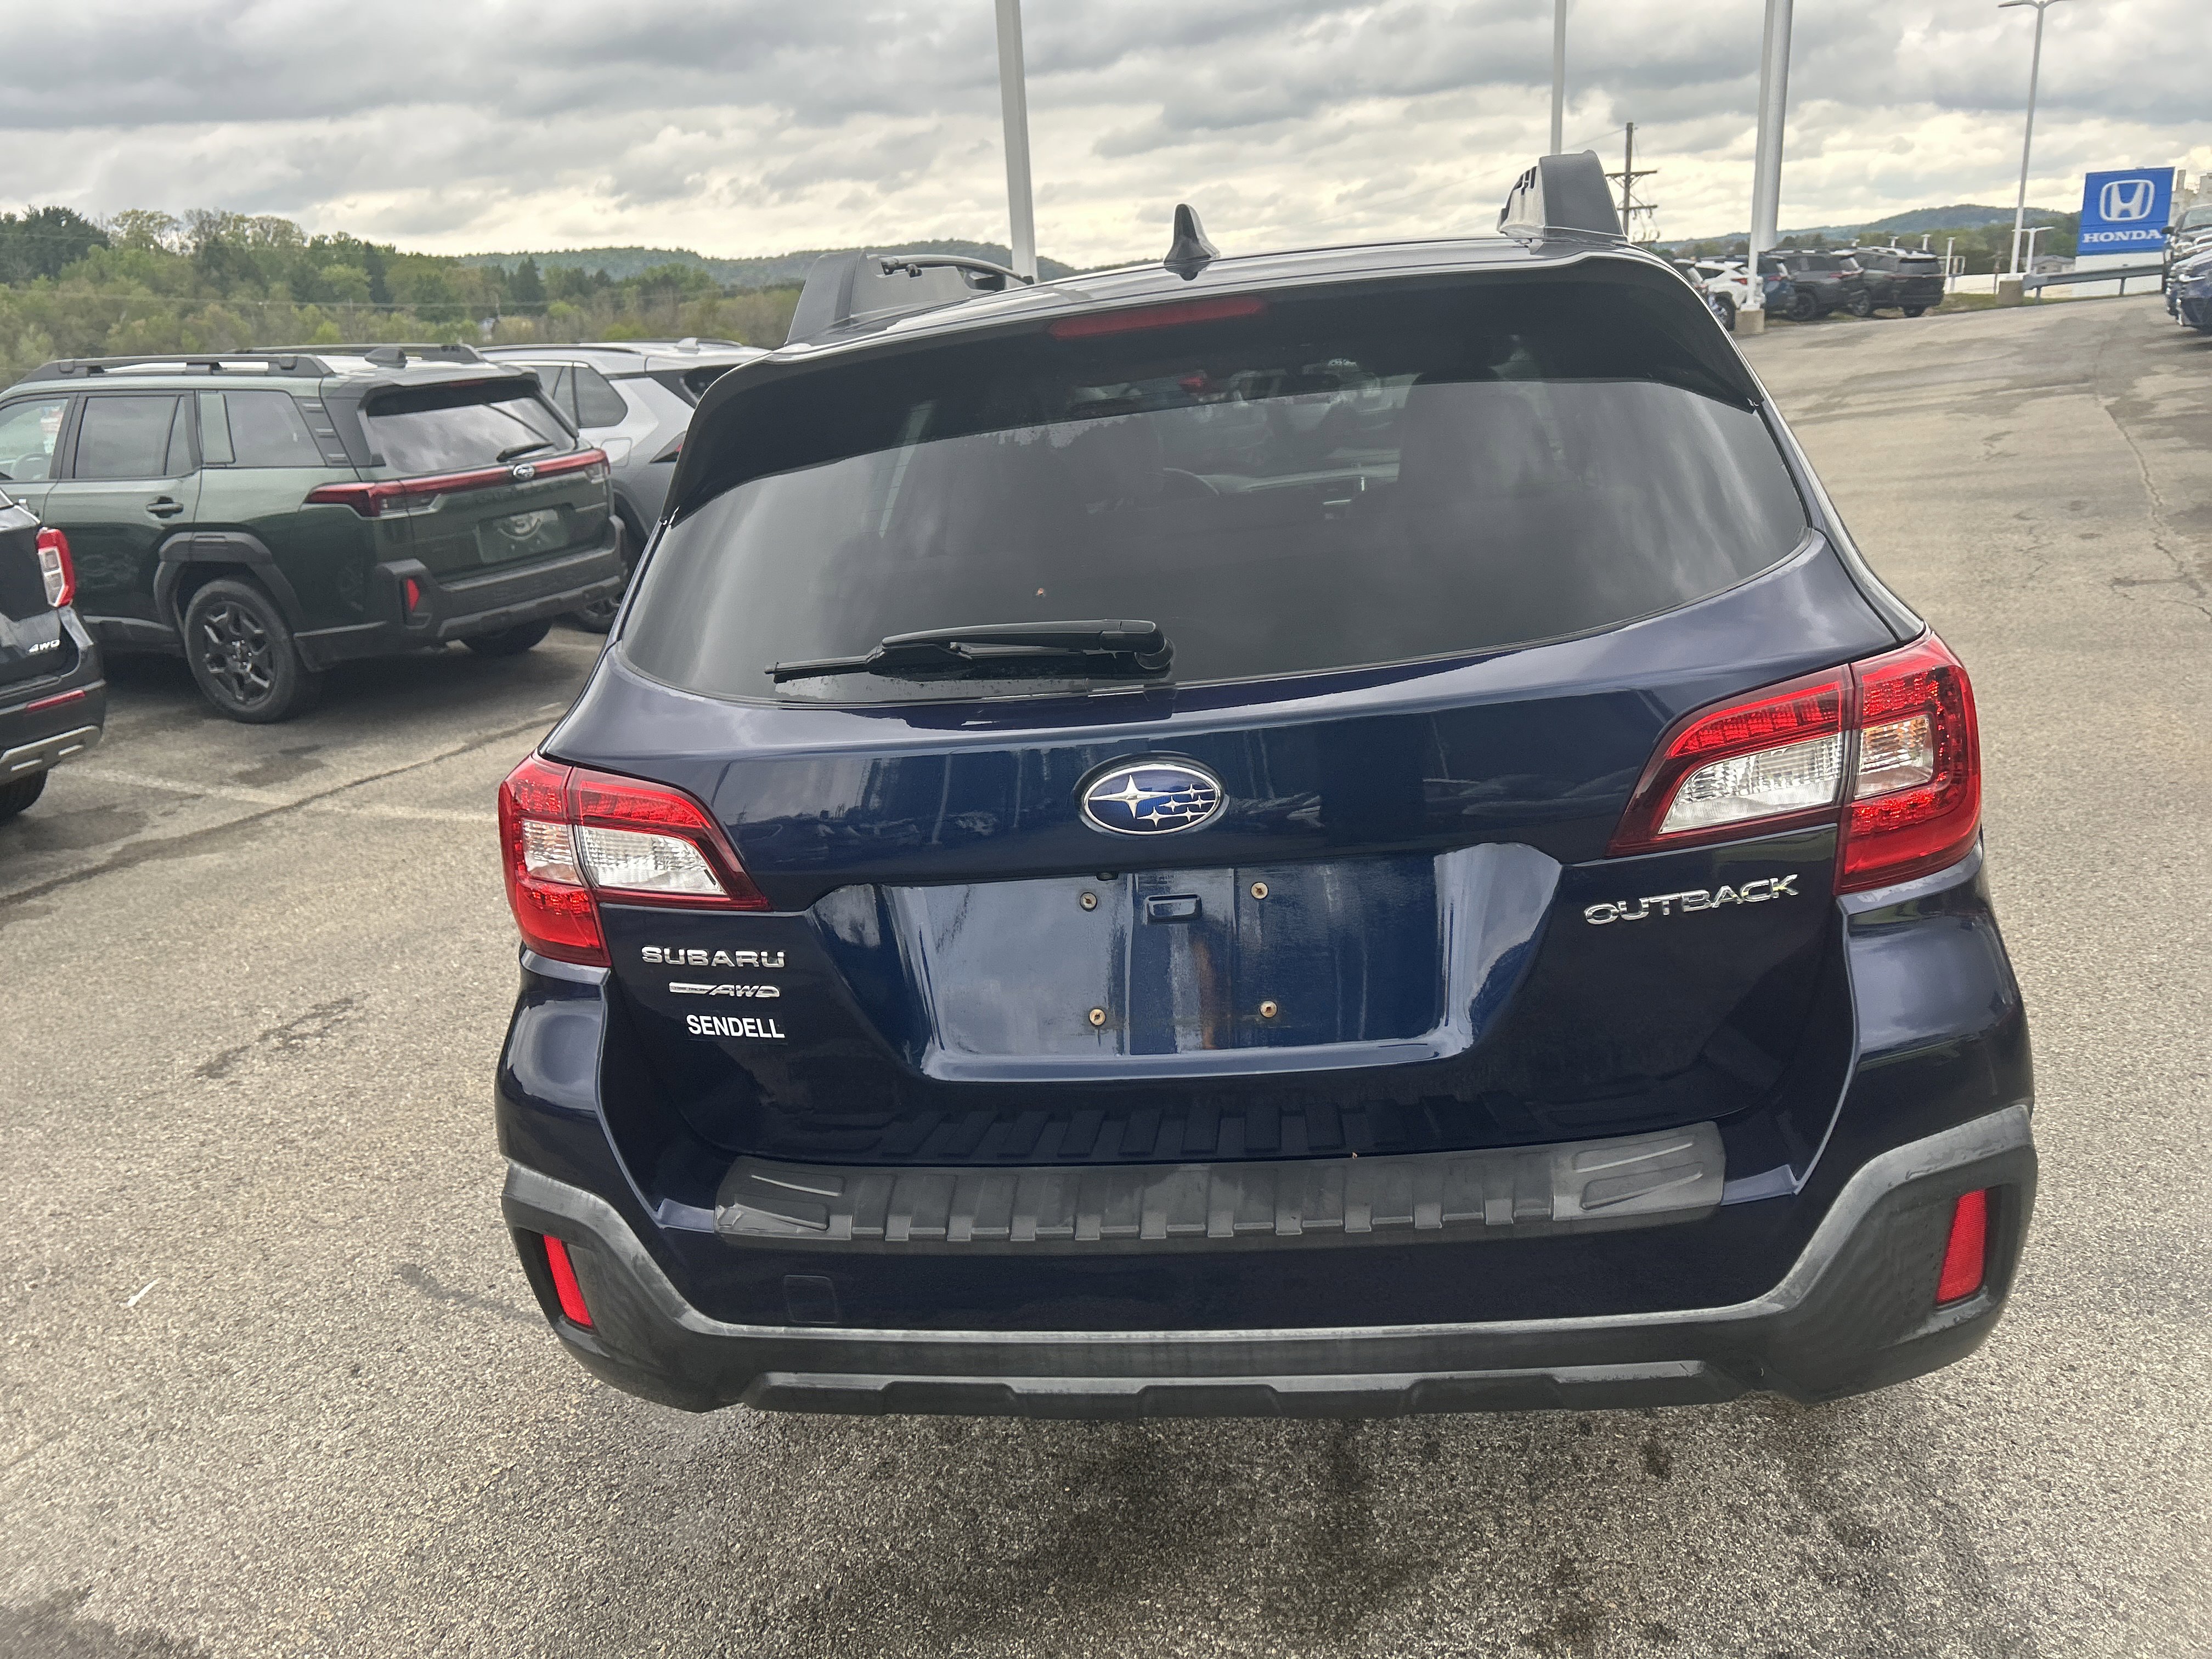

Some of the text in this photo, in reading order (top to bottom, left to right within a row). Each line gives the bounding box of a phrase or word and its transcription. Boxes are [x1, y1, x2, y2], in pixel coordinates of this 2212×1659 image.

[2083, 229, 2163, 244] HONDA
[1584, 874, 1799, 925] OUTBACK
[641, 946, 785, 968] SUBARU
[709, 984, 780, 998] AWD
[686, 1014, 785, 1038] SENDELL
